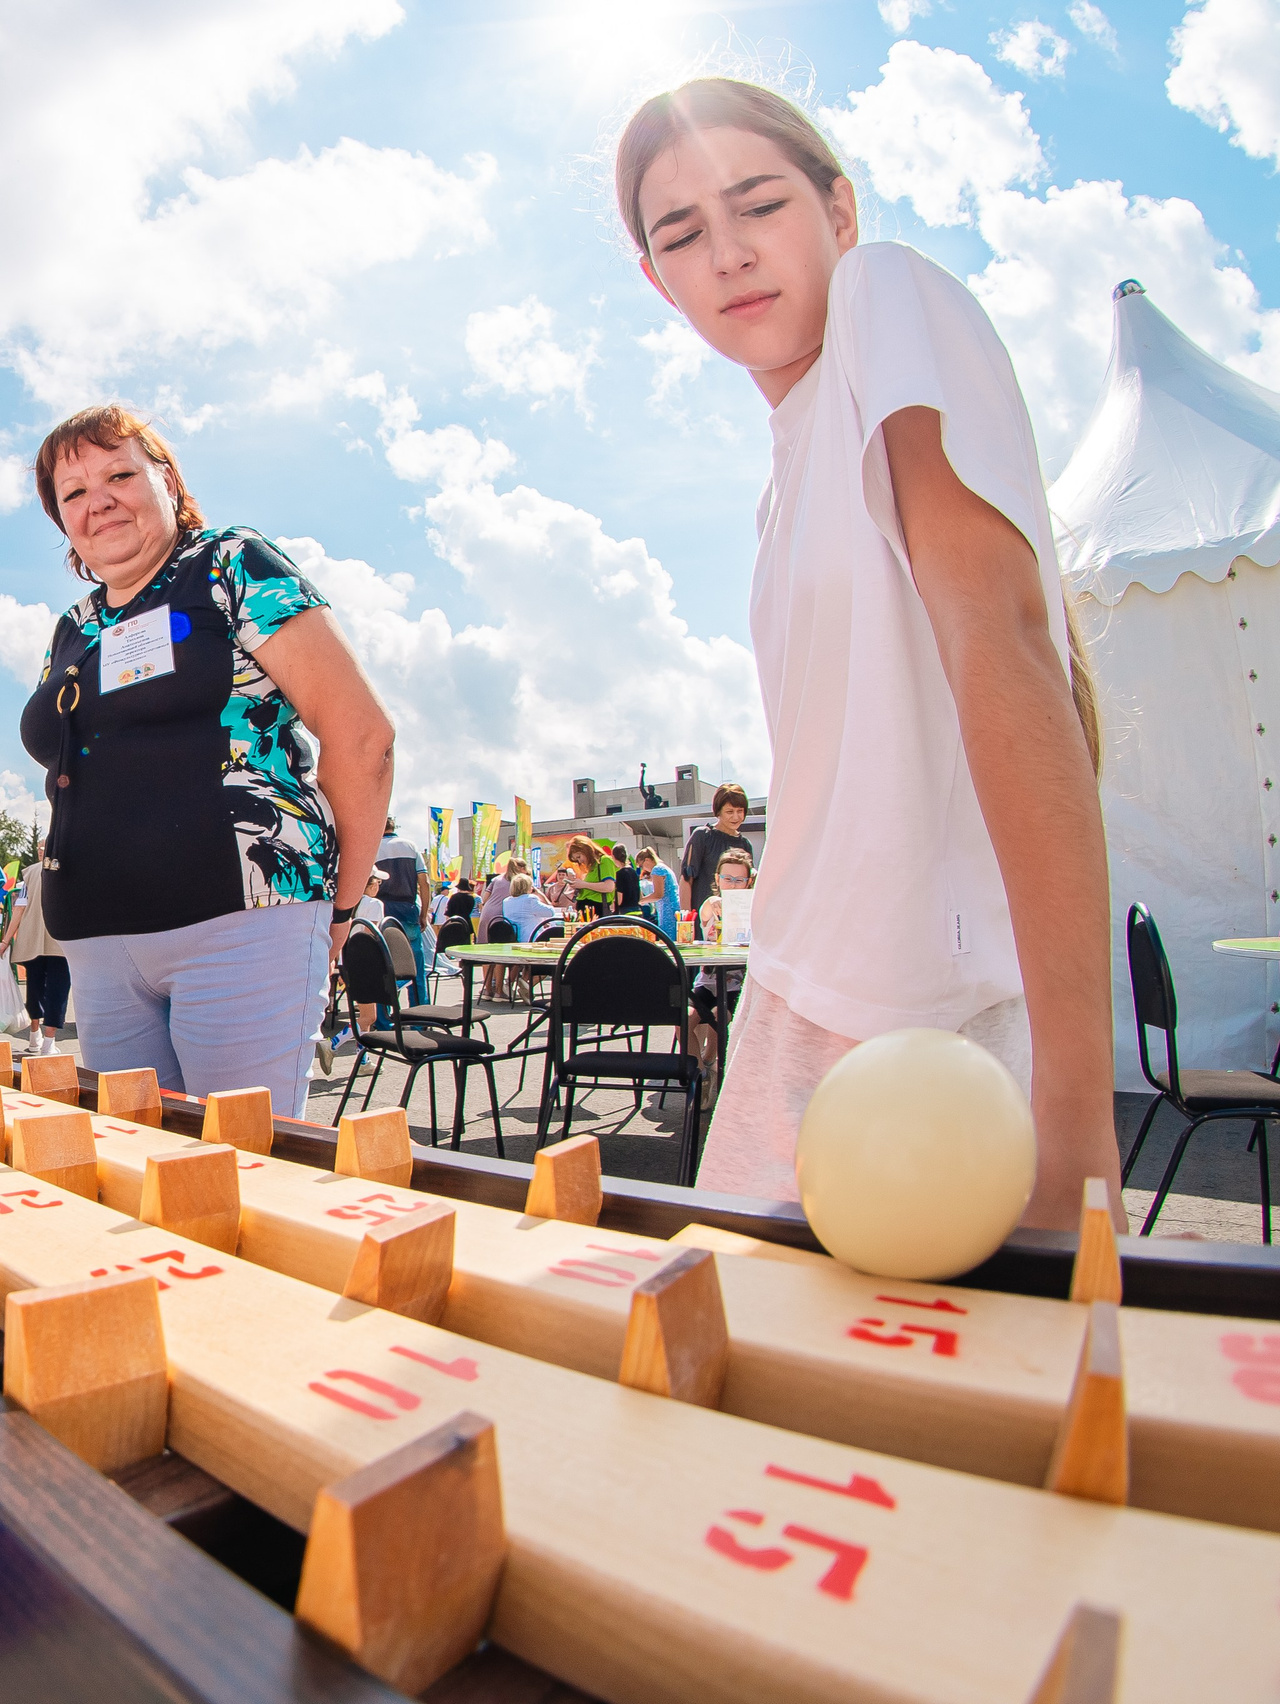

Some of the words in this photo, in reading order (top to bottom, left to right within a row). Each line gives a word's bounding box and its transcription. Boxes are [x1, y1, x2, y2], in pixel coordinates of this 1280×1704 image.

[325, 1193, 429, 1227] 25
[548, 1244, 661, 1287] 10
[846, 1295, 969, 1357] 15
[307, 1345, 480, 1421] 10
[704, 1463, 897, 1603] 15
